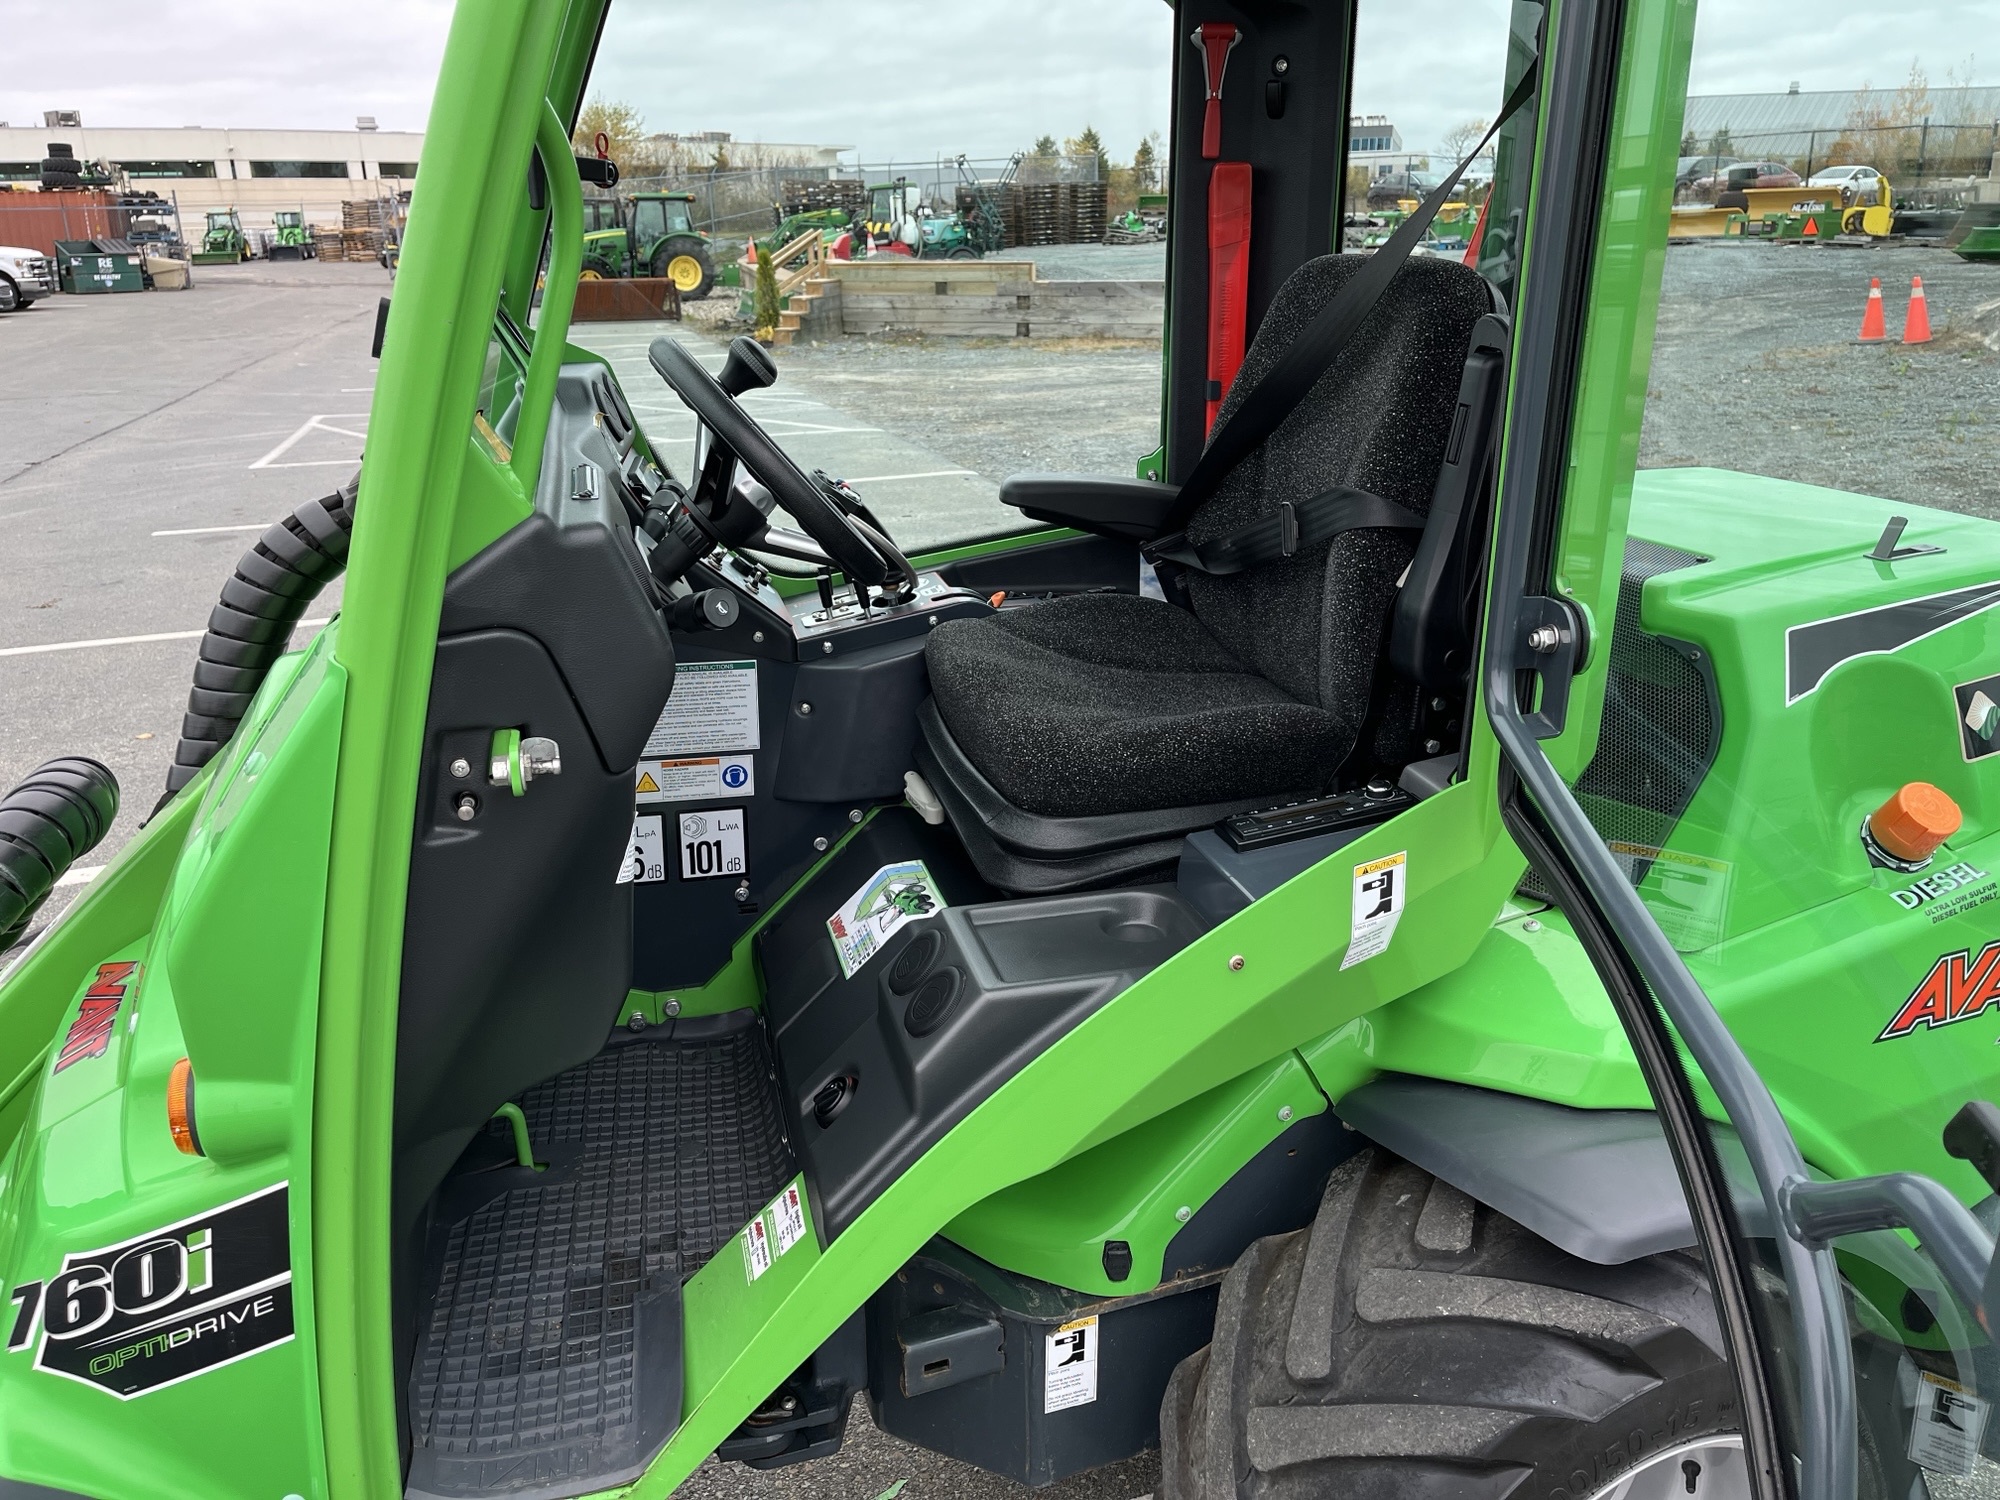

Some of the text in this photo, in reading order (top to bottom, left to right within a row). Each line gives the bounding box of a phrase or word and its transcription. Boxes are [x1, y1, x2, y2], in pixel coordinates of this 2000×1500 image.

[689, 664, 734, 672] INSTRUCTIONS
[647, 864, 662, 879] dB
[685, 839, 741, 875] 101 dB
[1369, 858, 1398, 872] CAUTION
[1889, 861, 1992, 911] DIESEL
[1924, 882, 1998, 918] ULTRA LOW SULFUR
[1931, 891, 2000, 925] DIESEL FUEL ONLY
[53, 960, 139, 1077] AVANT
[8, 1228, 213, 1353] 760i
[88, 1294, 275, 1376] OPTIDRIVE
[1061, 1320, 1090, 1331] CAUTION
